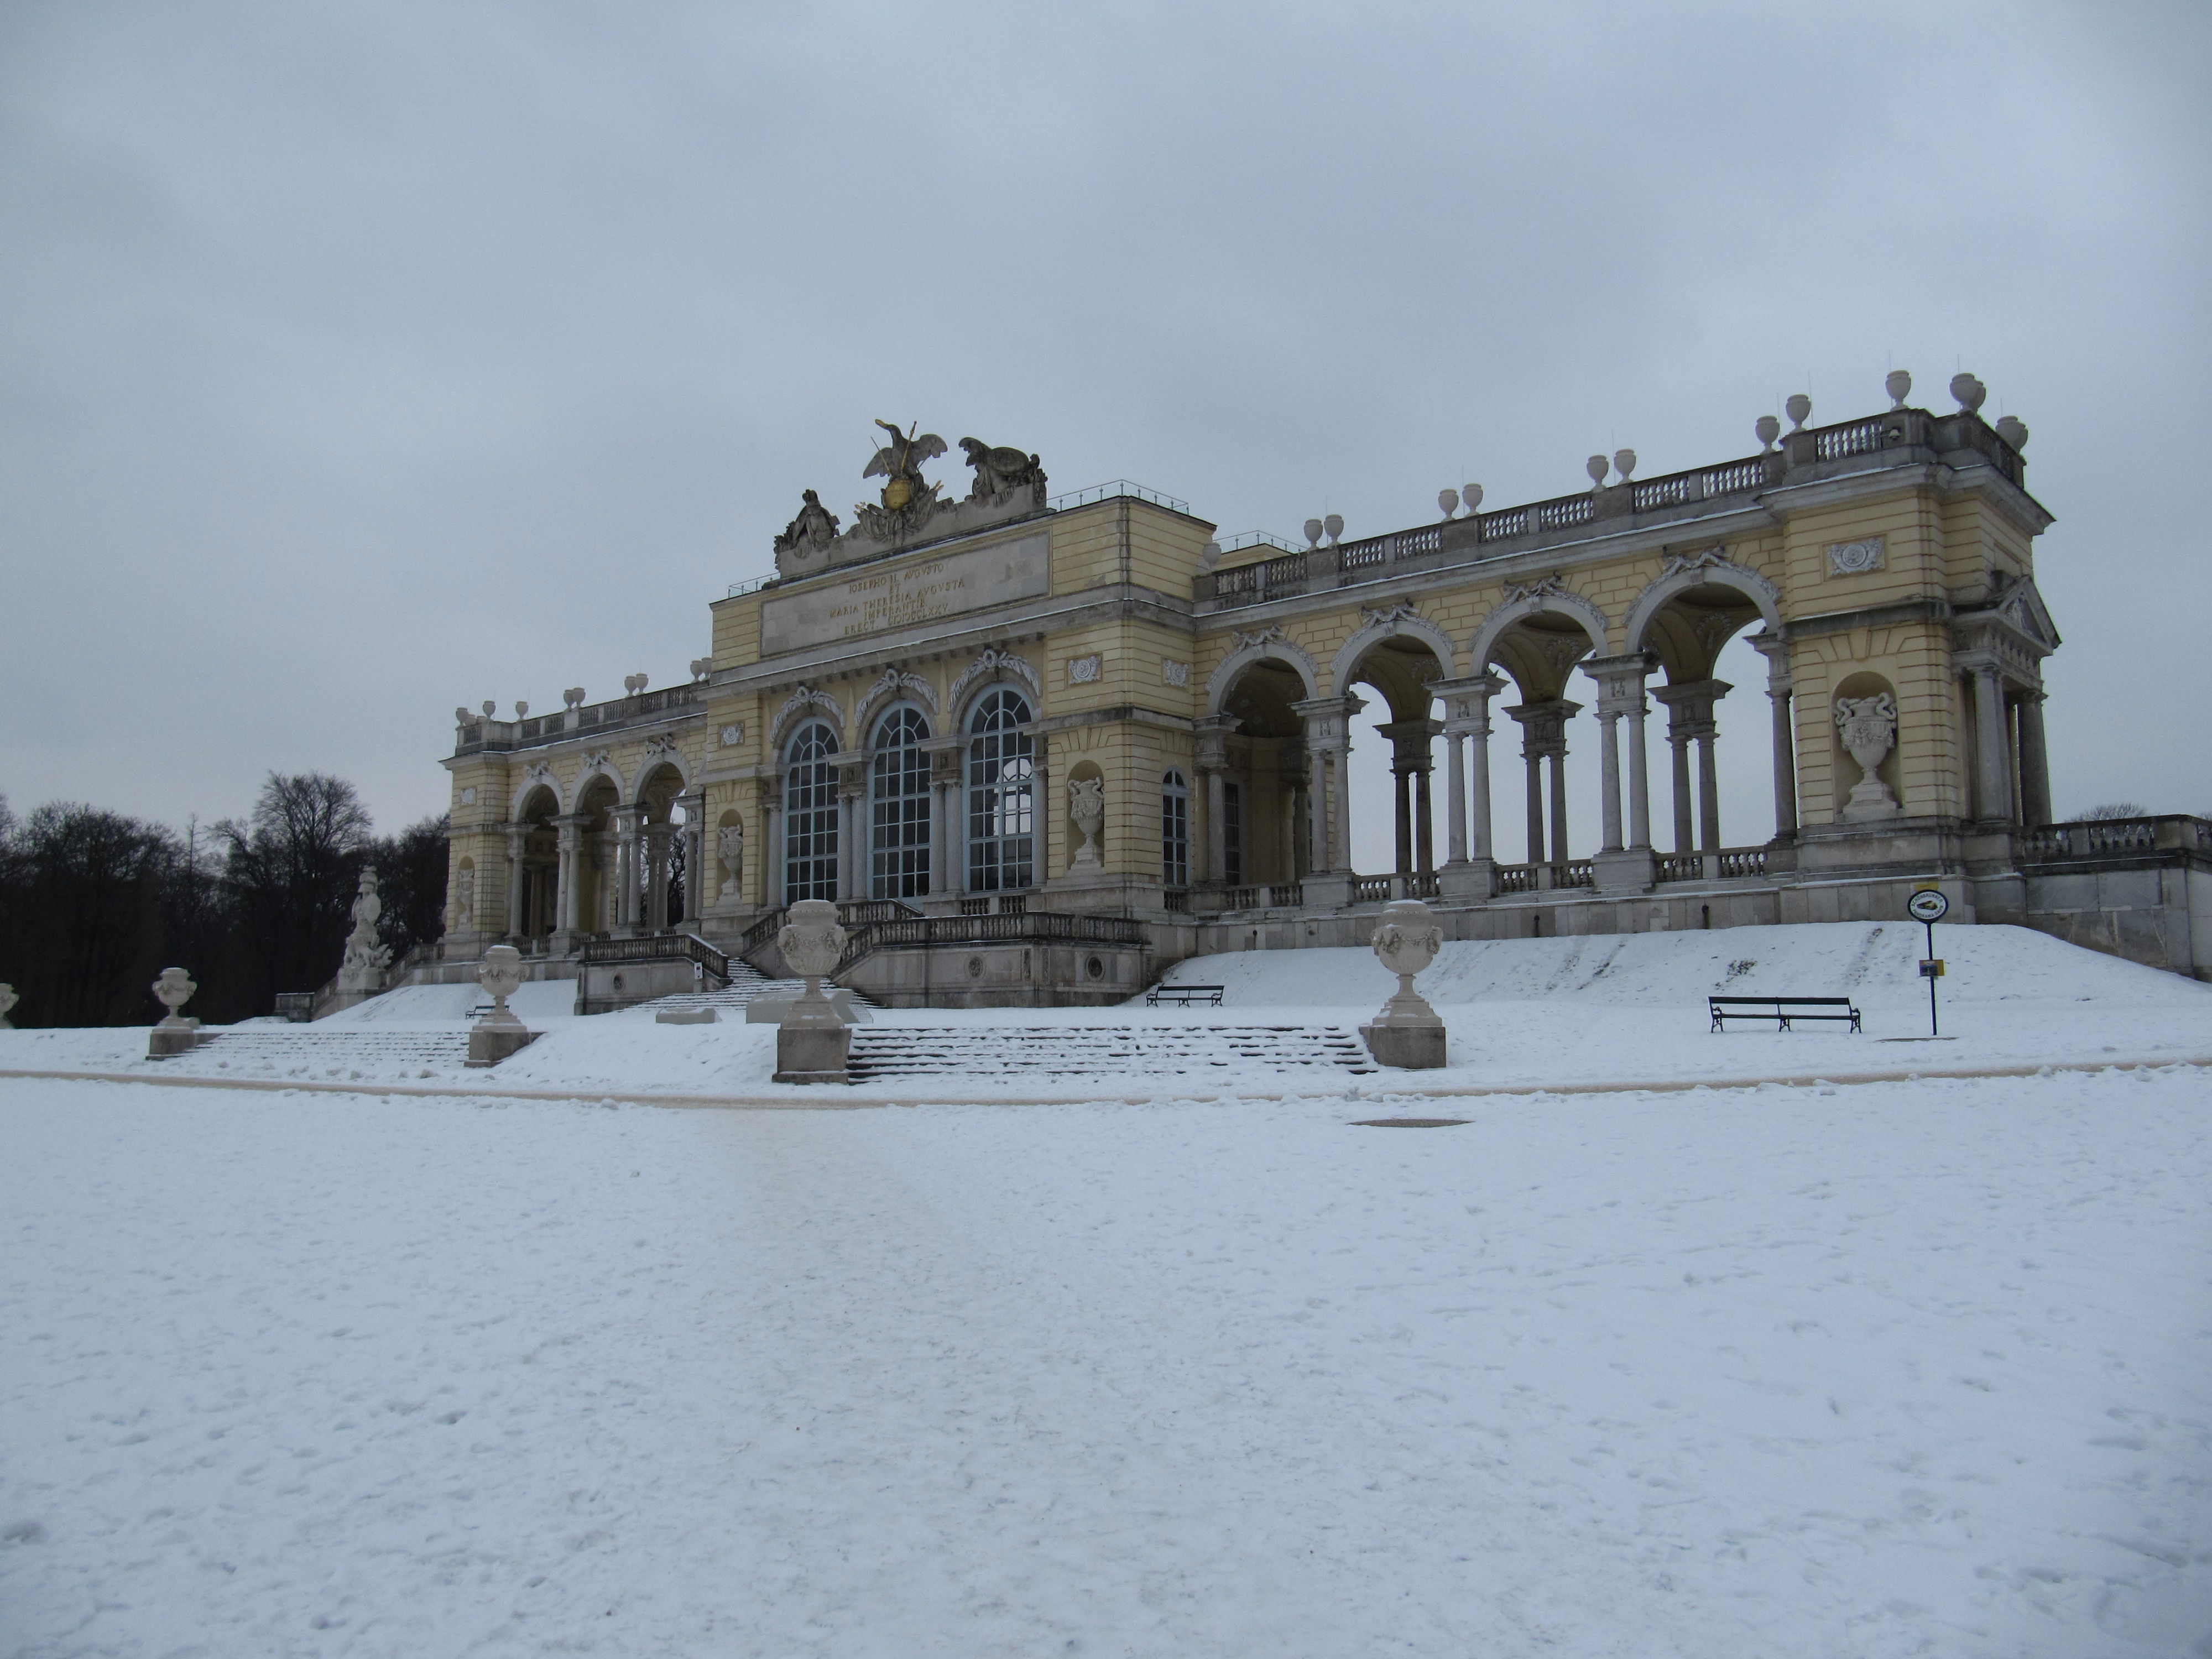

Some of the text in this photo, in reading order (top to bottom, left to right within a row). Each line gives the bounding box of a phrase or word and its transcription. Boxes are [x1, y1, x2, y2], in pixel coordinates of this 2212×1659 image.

[849, 577, 886, 594] IOSEPHO
[904, 564, 944, 580] AVGVSTO
[889, 583, 901, 594] ET
[830, 578, 964, 618] MARIA THERESIA AVGVSTA
[844, 620, 879, 635] ERECT.
[1912, 909, 1934, 918] PANORAMA
